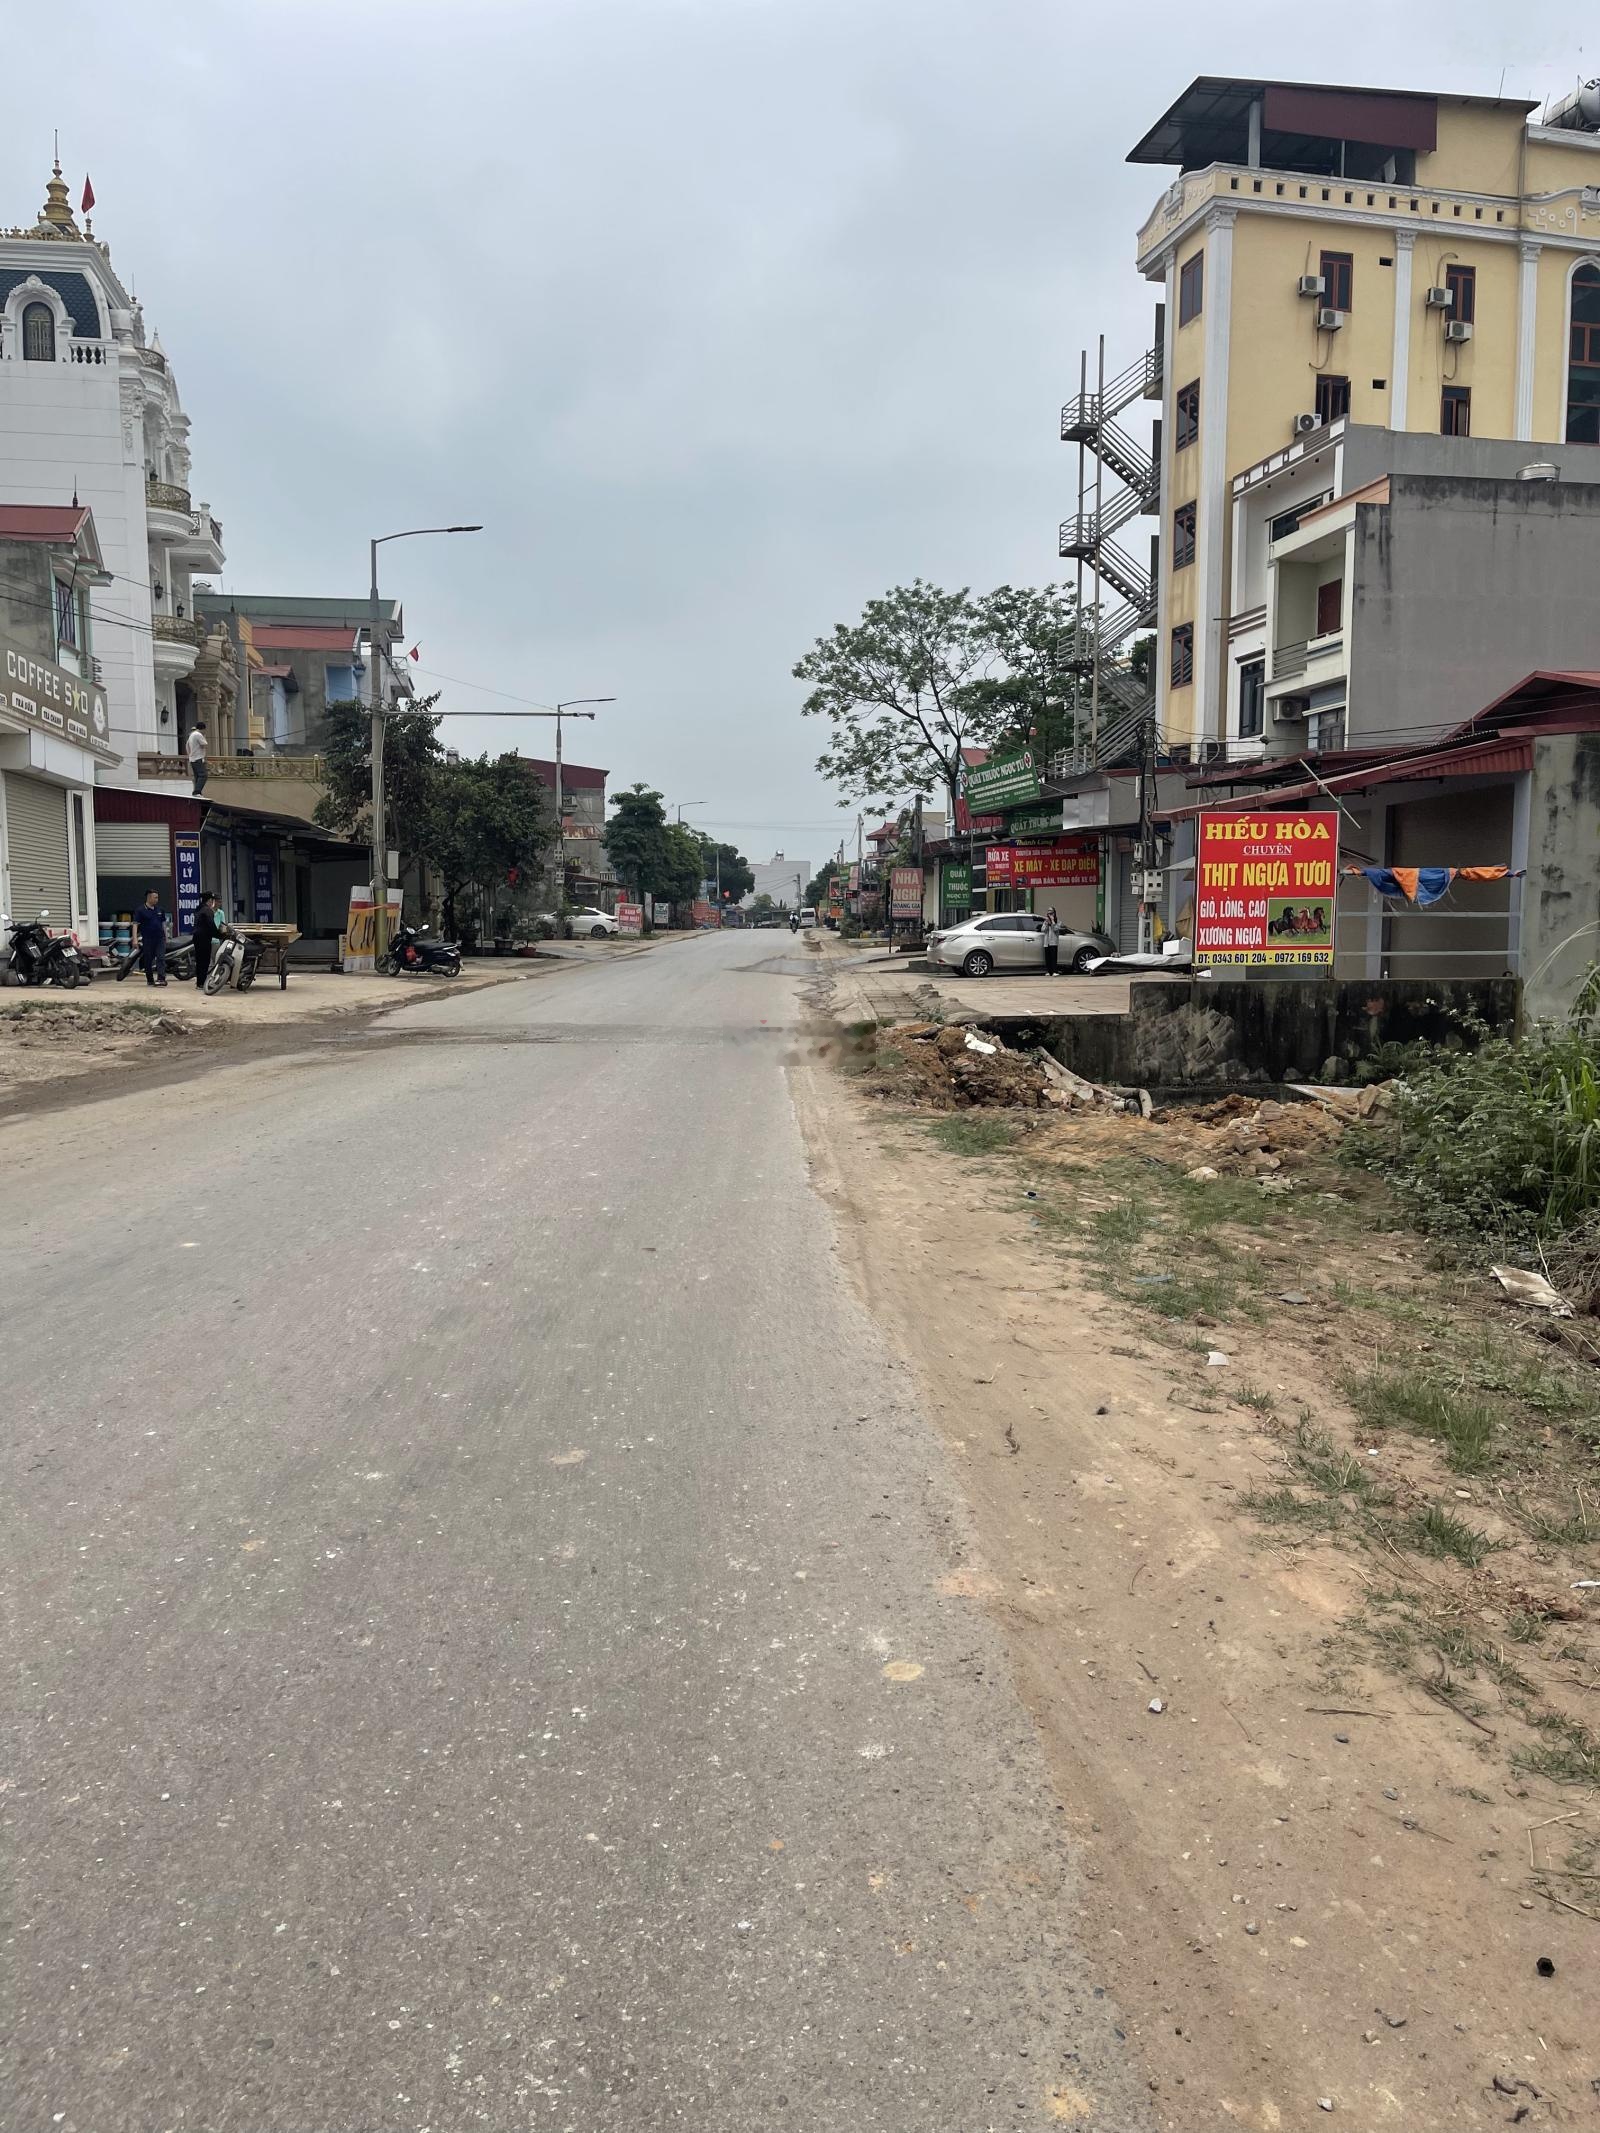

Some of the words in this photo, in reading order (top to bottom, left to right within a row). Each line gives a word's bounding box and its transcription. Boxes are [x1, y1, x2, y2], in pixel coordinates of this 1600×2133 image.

[7, 650, 60, 700] COFFEE
[1205, 816, 1268, 840] HIẾU
[1275, 818, 1330, 839] HÒA
[988, 848, 1000, 861] RỬA
[1001, 851, 1009, 861] XE
[1243, 843, 1292, 854] CHUYÊN
[180, 852, 195, 864] ĐẠI
[1014, 861, 1024, 873] XE
[1026, 859, 1043, 872] MÁY
[1050, 860, 1060, 871] XE
[1062, 860, 1076, 873] ĐẠP
[1078, 857, 1096, 872] ĐIỆN
[183, 867, 193, 878] LÝ
[895, 870, 919, 884] NHÀ
[1203, 863, 1238, 891] THỊT
[1243, 860, 1288, 891] NGỰA
[1294, 860, 1331, 885] TƯƠI
[180, 882, 198, 893] SƠN
[893, 885, 920, 900] NGHỈ
[948, 880, 968, 891] THUỐC
[1200, 896, 1218, 919] GIÒ,
[1220, 896, 1246, 919] LÒNG,
[1249, 900, 1266, 917] CAO
[1199, 926, 1232, 945] XƯƠNG
[1235, 926, 1262, 948] NGỰA
[1198, 954, 1210, 964] ĐT:
[1213, 954, 1232, 963] 0343
[1235, 954, 1249, 963] 601
[1252, 954, 1266, 963] 204
[1275, 953, 1294, 963] 0972
[1297, 953, 1311, 962] 169
